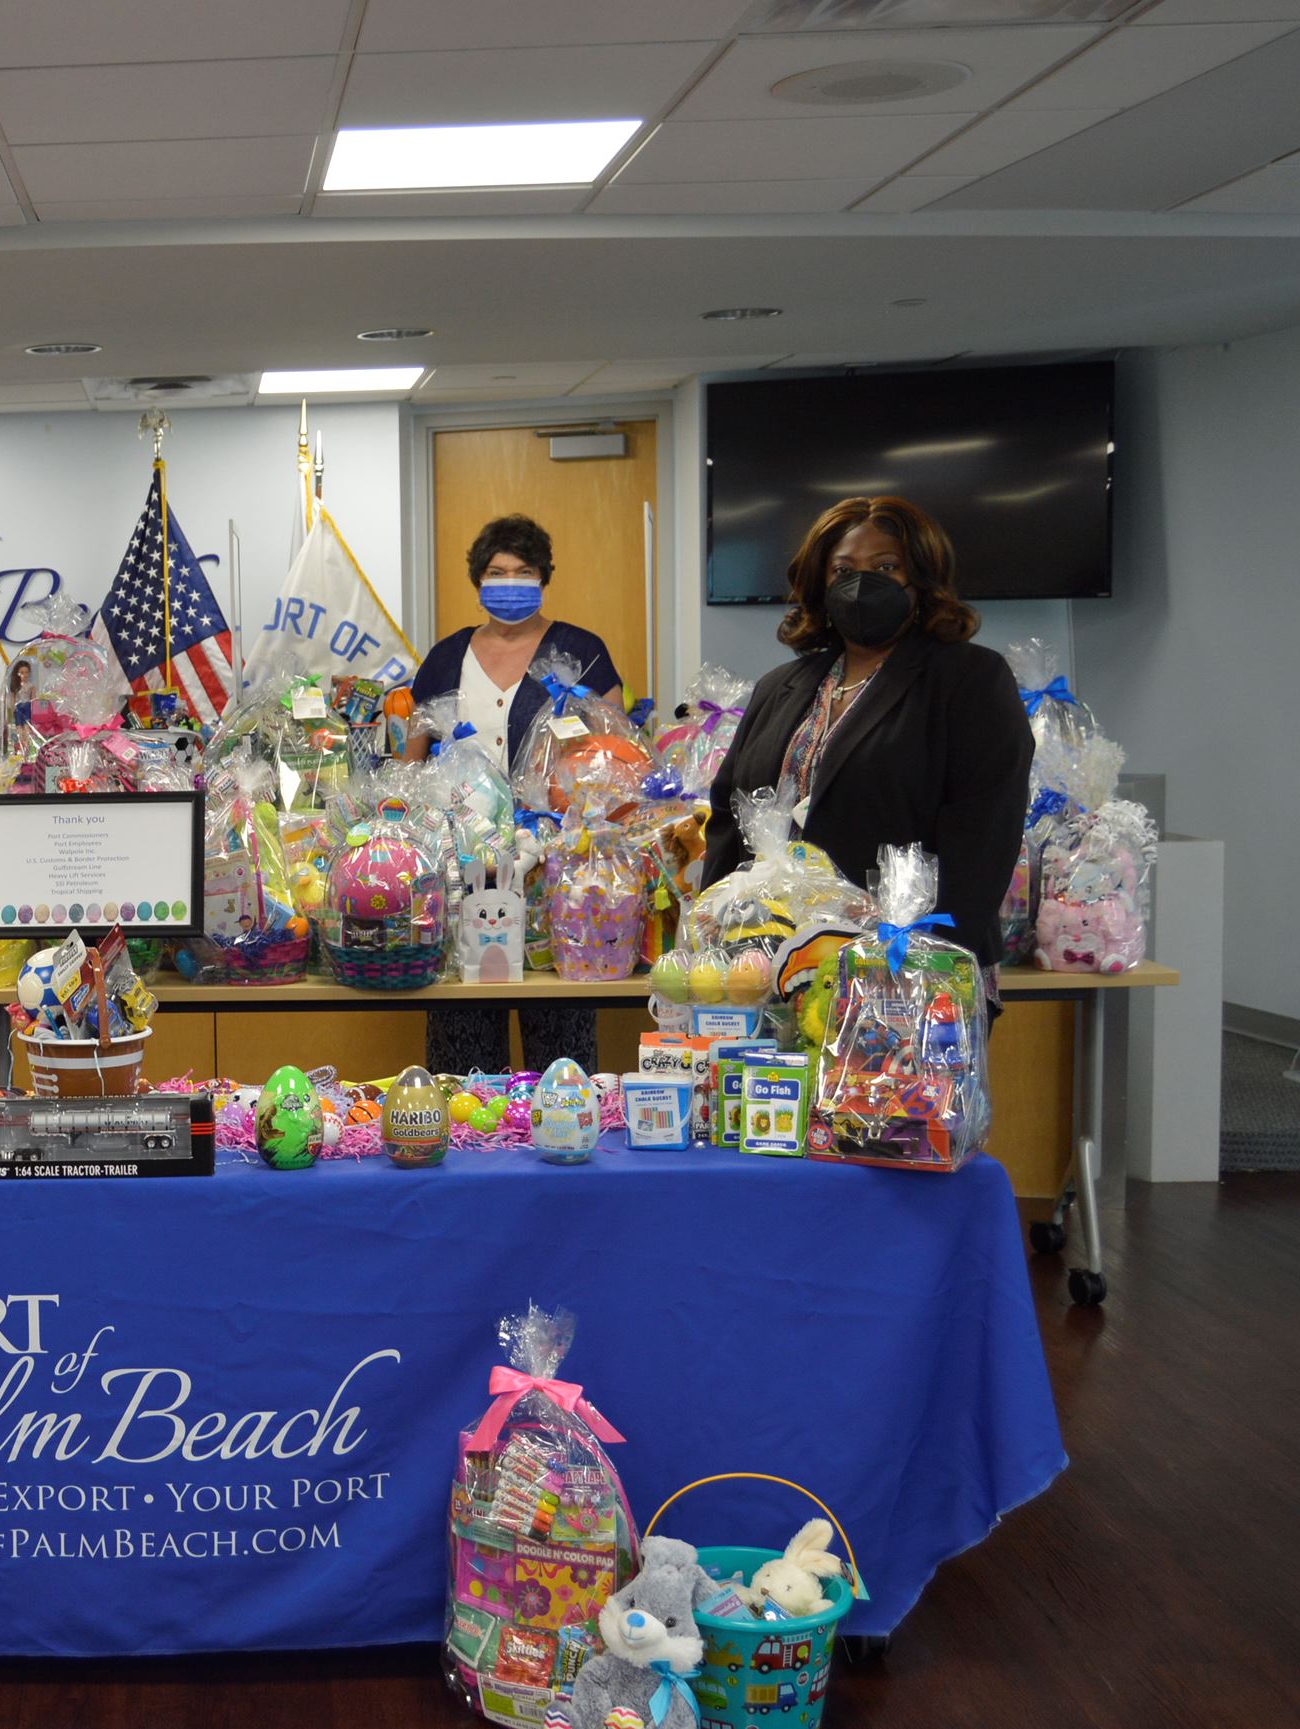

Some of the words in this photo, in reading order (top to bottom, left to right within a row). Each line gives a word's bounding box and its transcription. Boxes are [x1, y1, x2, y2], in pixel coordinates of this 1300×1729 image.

[330, 620, 381, 663] OF
[52, 815, 83, 825] Thank
[86, 815, 105, 826] you
[755, 1084, 769, 1095] Go
[771, 1084, 792, 1096] Fish
[390, 1108, 442, 1126] HARIBO
[393, 1127, 440, 1138] Goldbears
[15, 1165, 32, 1177] 1:64
[34, 1164, 60, 1177] SCALE
[62, 1164, 138, 1176] TRACTOR-TRAILER
[51, 1325, 115, 1394] of
[91, 1348, 401, 1464] Beach
[166, 1481, 279, 1512] YOUR
[292, 1473, 391, 1509] PORT
[466, 1507, 485, 1518] MINI
[516, 1543, 552, 1558] DOODLE
[563, 1552, 596, 1565] COLOR
[596, 1556, 614, 1568] PAD
[506, 1639, 546, 1660] Skittles
